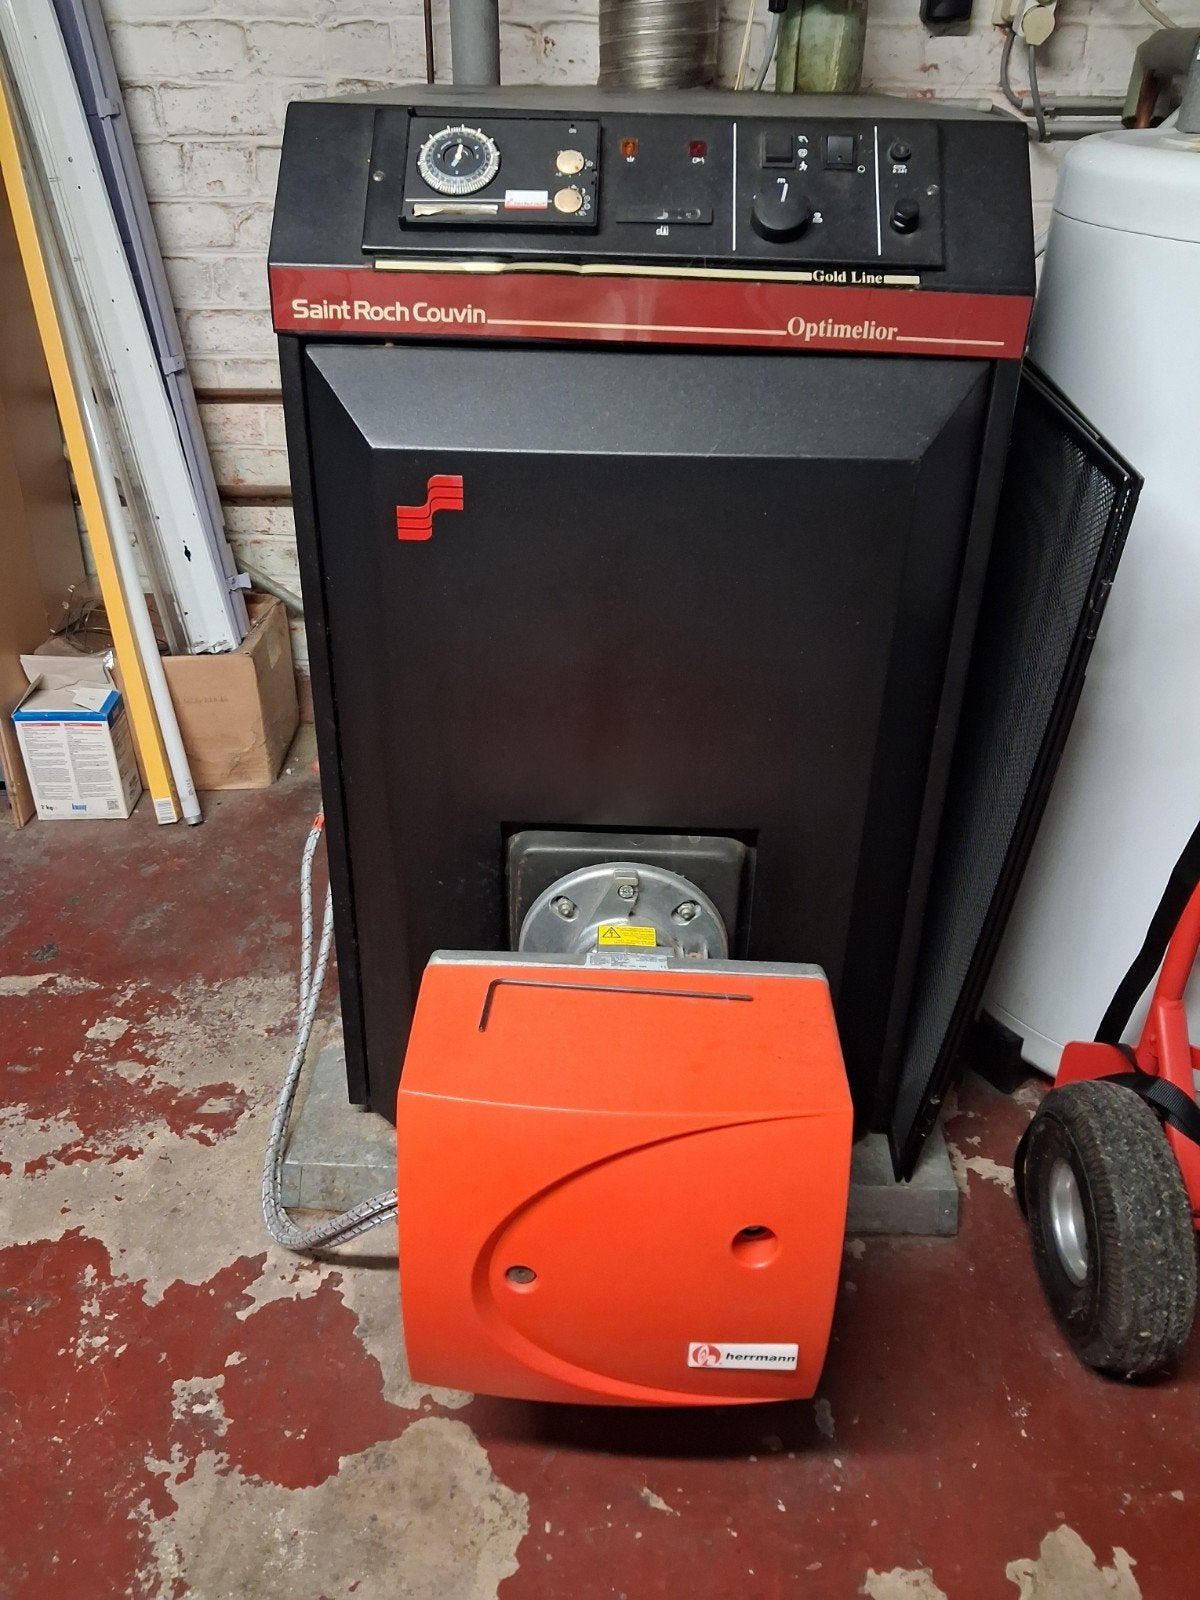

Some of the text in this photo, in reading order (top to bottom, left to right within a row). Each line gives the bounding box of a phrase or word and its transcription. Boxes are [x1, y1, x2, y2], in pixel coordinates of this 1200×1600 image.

[812, 270, 883, 284] Gold Line
[291, 298, 486, 324] Saint Roch Couvin
[787, 316, 898, 342] Optimelior
[725, 1352, 796, 1363] herrmann
